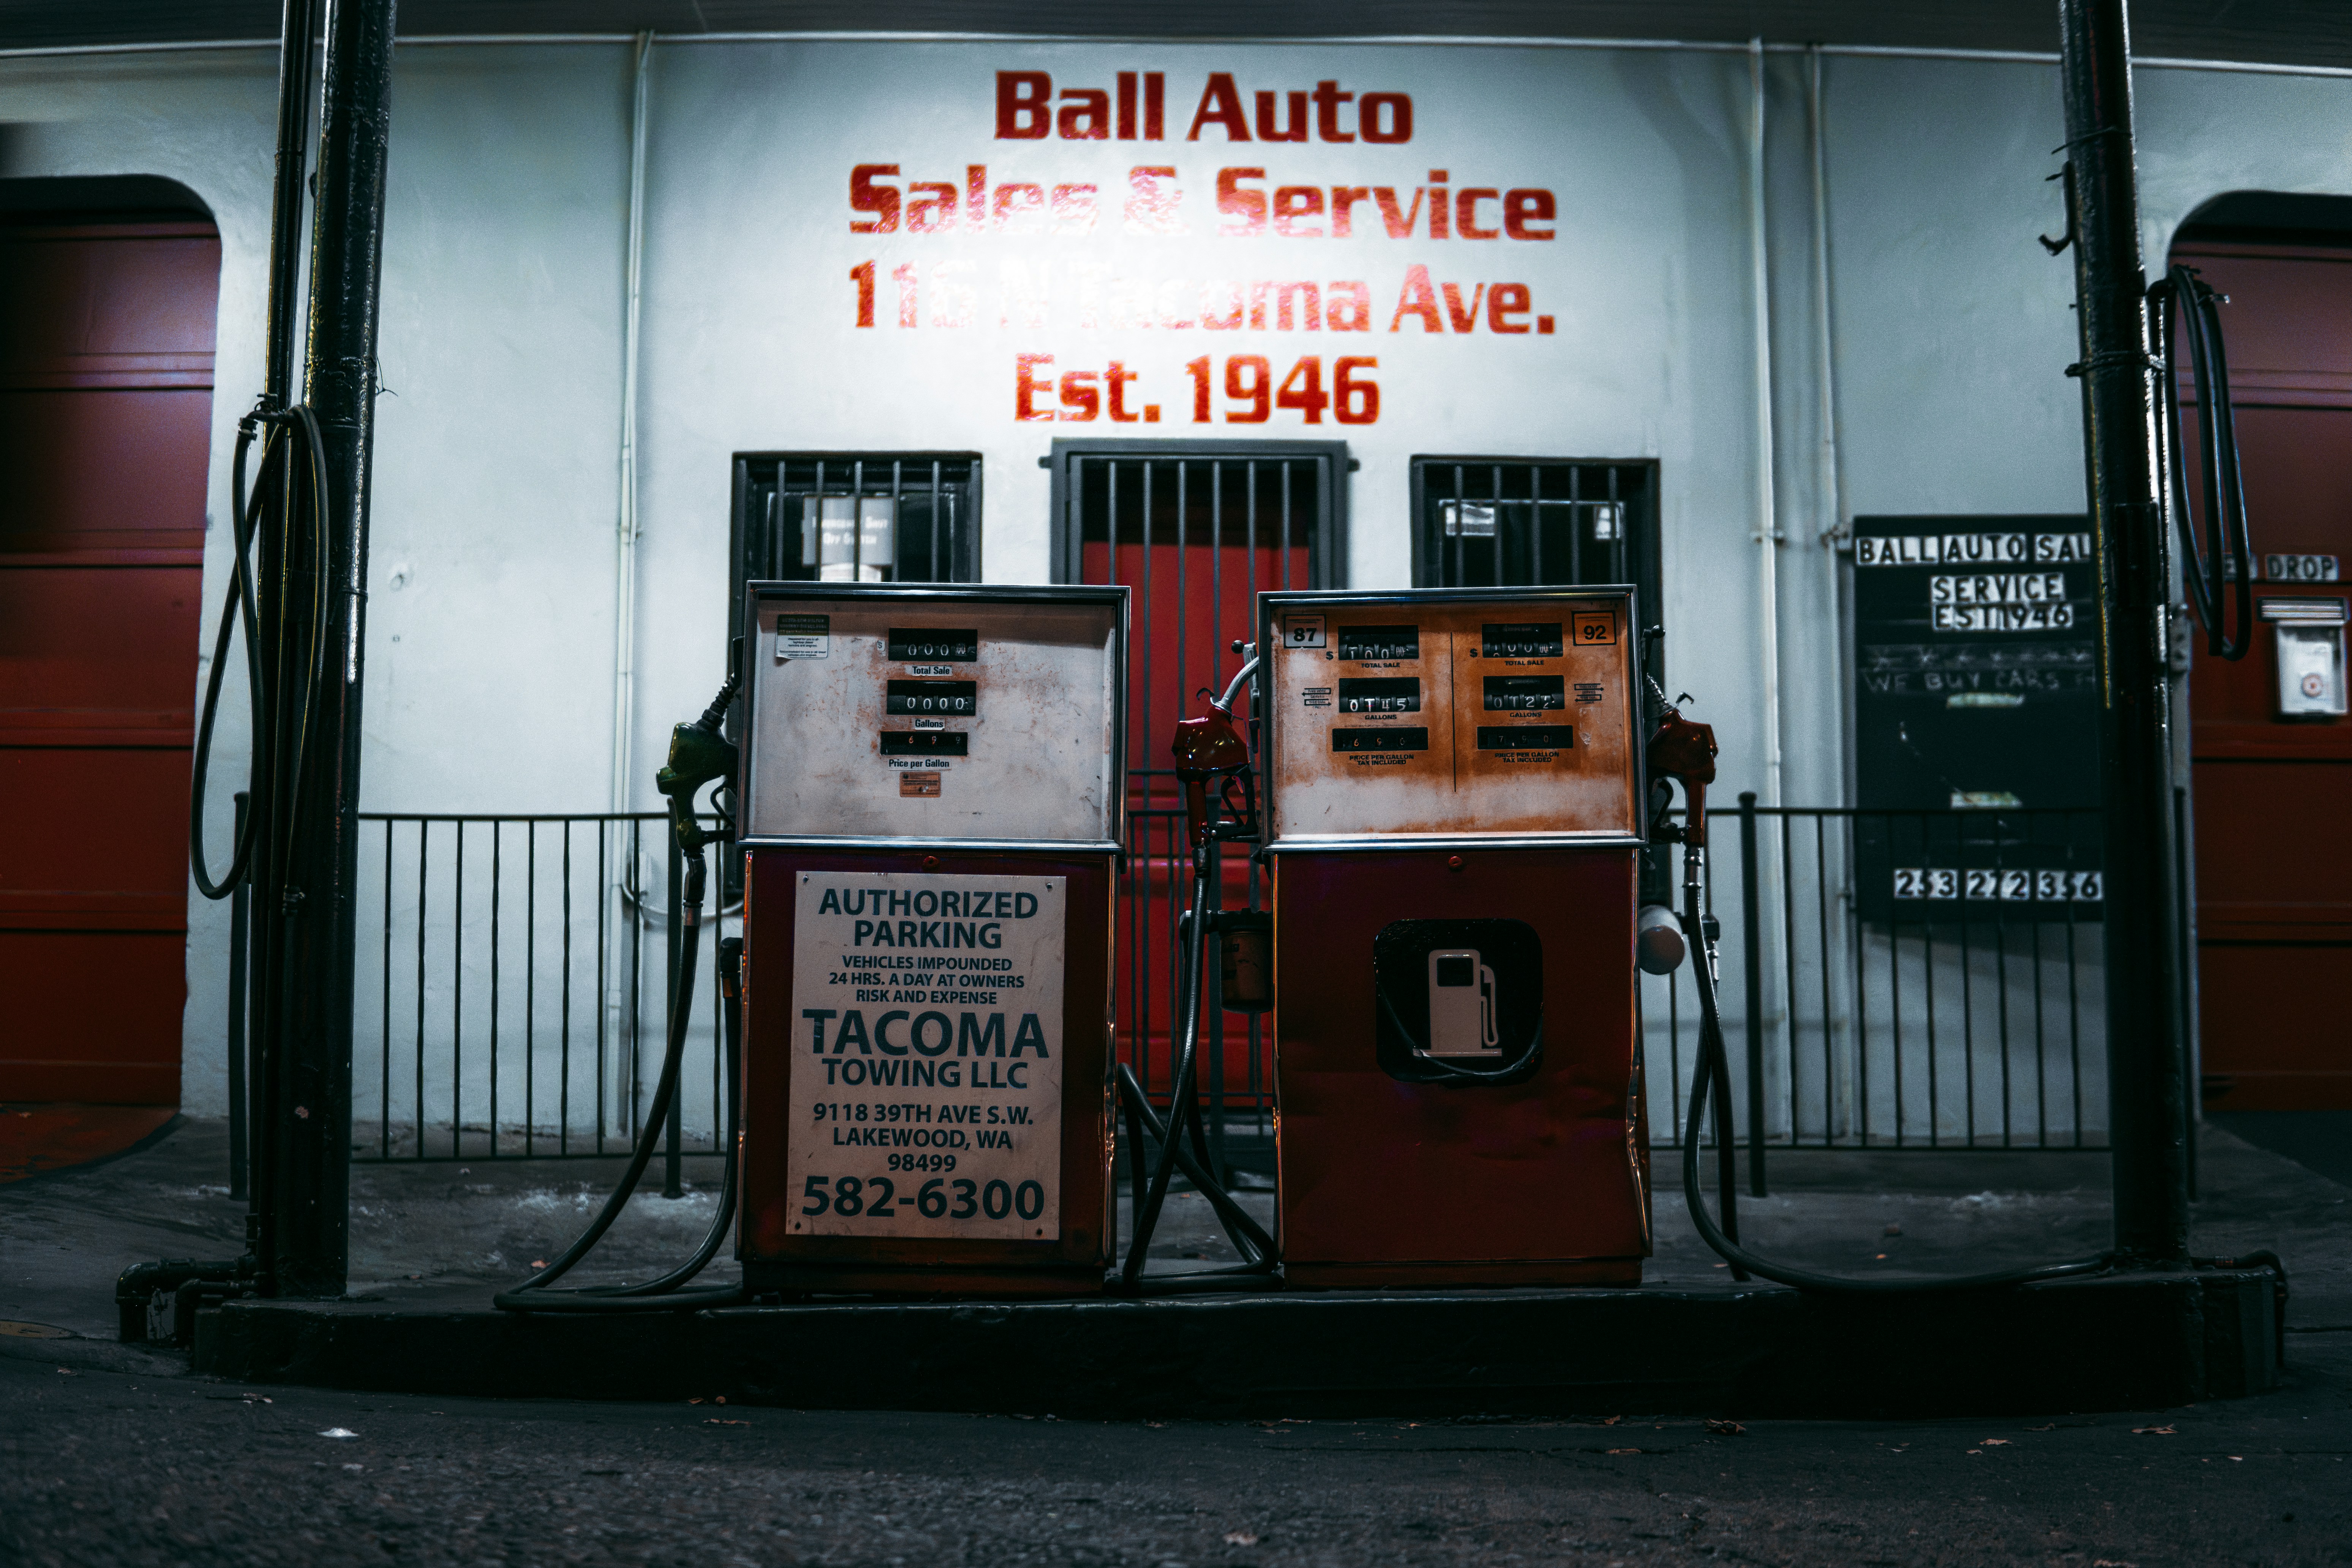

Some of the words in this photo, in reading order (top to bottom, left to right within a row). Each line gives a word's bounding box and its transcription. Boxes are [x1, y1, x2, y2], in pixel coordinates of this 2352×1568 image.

[994, 71, 1165, 141] Ball
[1185, 73, 1413, 144] Auto
[850, 163, 1099, 234] Sales
[1123, 165, 1190, 236] &
[1216, 167, 1556, 240] Service
[1068, 260, 1370, 332] Tacoma
[1389, 264, 1555, 335] Ave.
[1015, 352, 1160, 423] Est.
[1185, 355, 1379, 425] 1946
[1860, 539, 1934, 563] BALL
[1947, 536, 2023, 560] AUTO
[2268, 556, 2333, 578] DROP
[1934, 574, 2061, 602] SERVICE
[1294, 628, 1317, 642] 87
[1584, 625, 1607, 640] 92
[1326, 651, 1334, 660] $
[1470, 648, 1478, 658] $
[912, 666, 930, 675] Total
[1863, 672, 1909, 693] WE
[1924, 672, 1980, 691] BUY
[1996, 669, 2059, 691] CARS
[915, 719, 943, 727] Gallons
[925, 759, 949, 767] Gallon
[818, 888, 1038, 918] AUTHORIZED
[854, 920, 1002, 949] PARKING
[842, 955, 914, 969] VEHICLES
[918, 957, 1012, 971] IMPOUNDED
[829, 972, 847, 985] 24
[851, 972, 885, 986] HRS.
[889, 973, 899, 986] A
[903, 974, 933, 986] DAY
[937, 974, 956, 987] AT
[959, 974, 1024, 988] OWNERS
[856, 989, 890, 1002] RISK
[893, 990, 927, 1003] AND
[930, 991, 997, 1004] EXPENSE
[802, 1008, 1050, 1058] TACOMA
[822, 1058, 961, 1087] TOWING
[971, 1061, 1028, 1089] LLC
[813, 1103, 868, 1121] 9118
[874, 1104, 931, 1123] 39TH
[937, 1105, 981, 1124] AVE
[987, 1105, 1034, 1125] S.W.
[833, 1127, 971, 1151] LAKEWOOD,
[976, 1130, 1013, 1149] WA
[887, 1153, 956, 1172] 98499
[802, 1176, 1045, 1220] 582-6300
